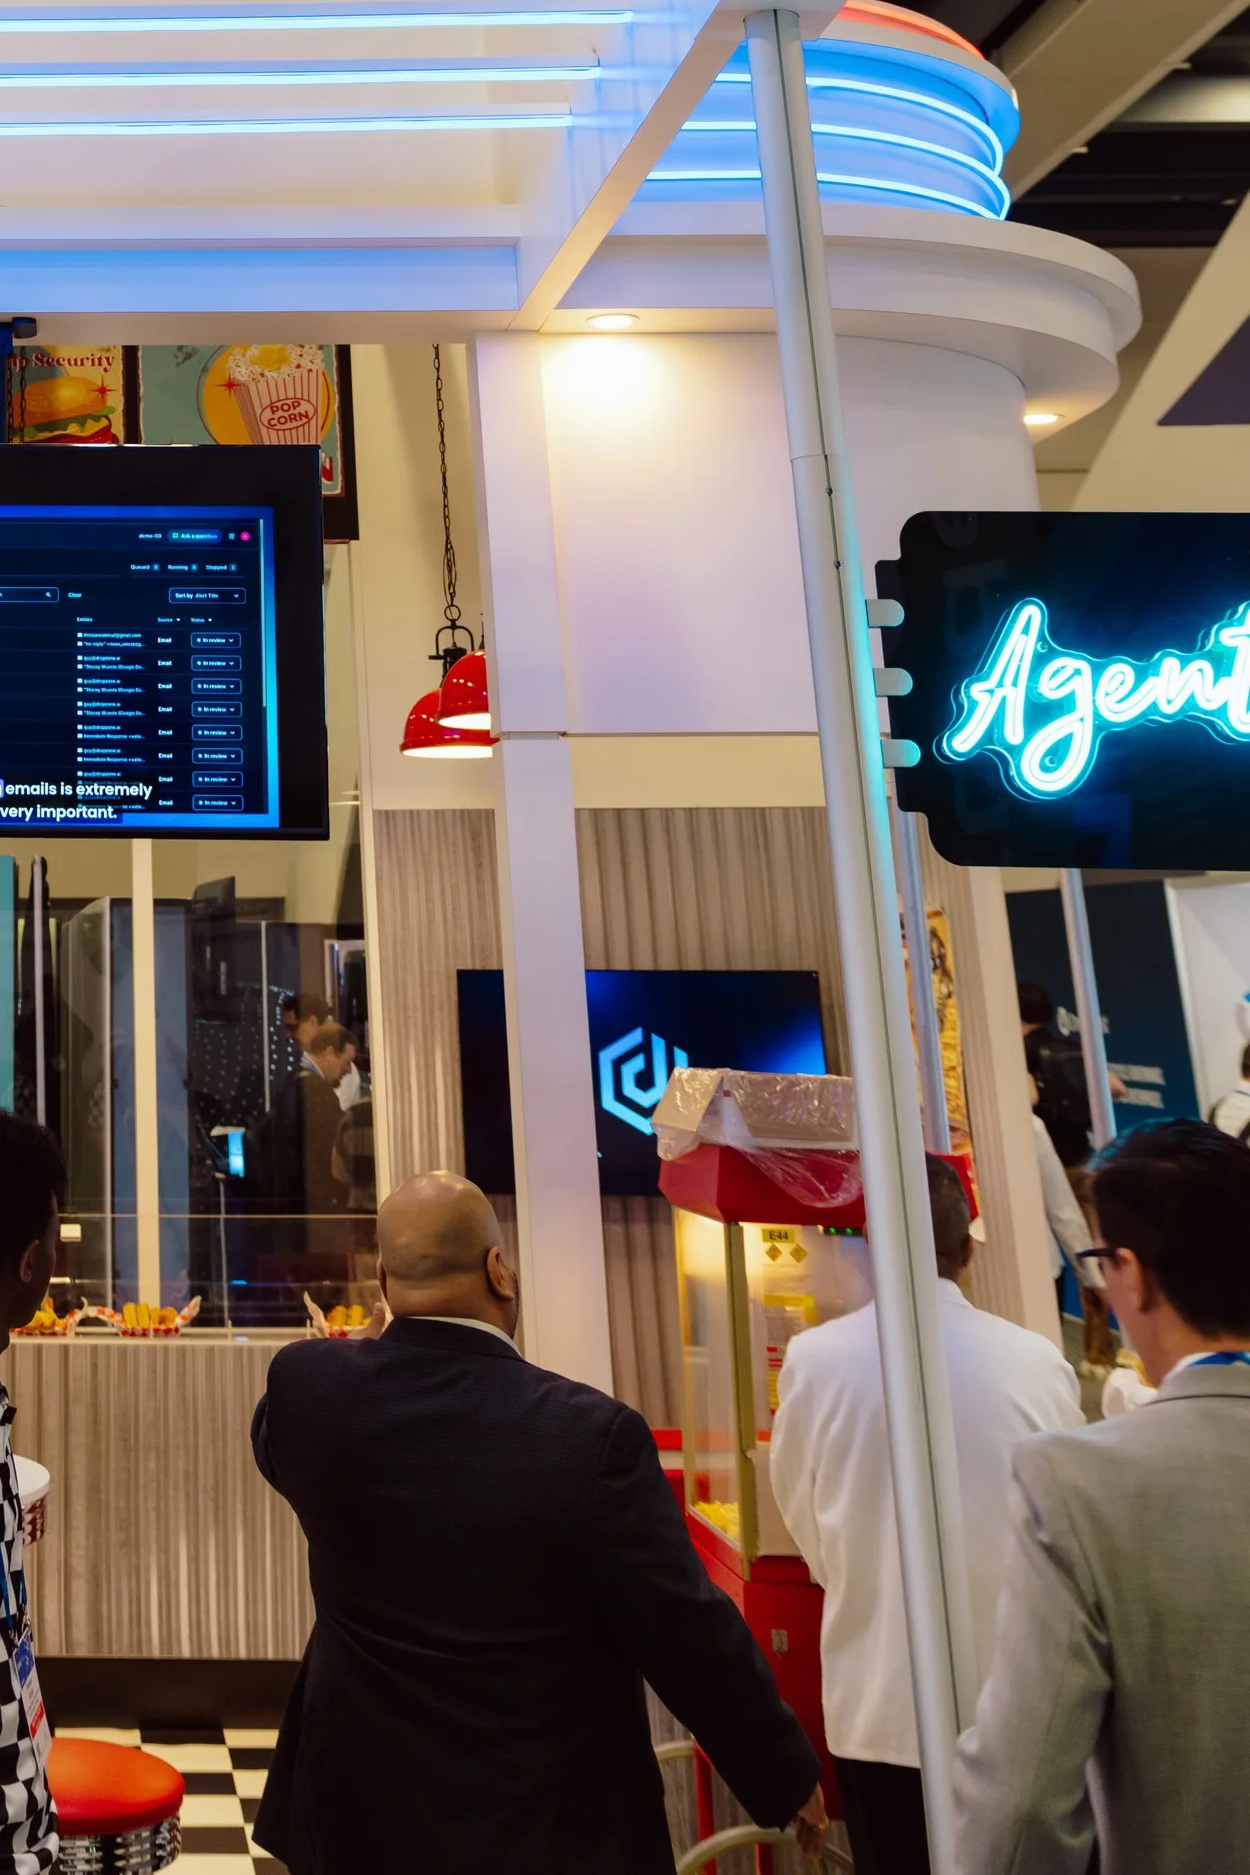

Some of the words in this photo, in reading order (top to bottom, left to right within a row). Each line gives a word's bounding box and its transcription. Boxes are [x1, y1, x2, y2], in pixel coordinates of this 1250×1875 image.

[32, 353, 115, 372] Security
[270, 400, 301, 414] POP
[267, 410, 309, 427] CORN
[5, 782, 56, 796] emails
[60, 782, 73, 796] is
[76, 782, 153, 800] extremely
[0, 807, 33, 821] very
[36, 804, 117, 822] important.
[769, 1230, 789, 1240] E44
